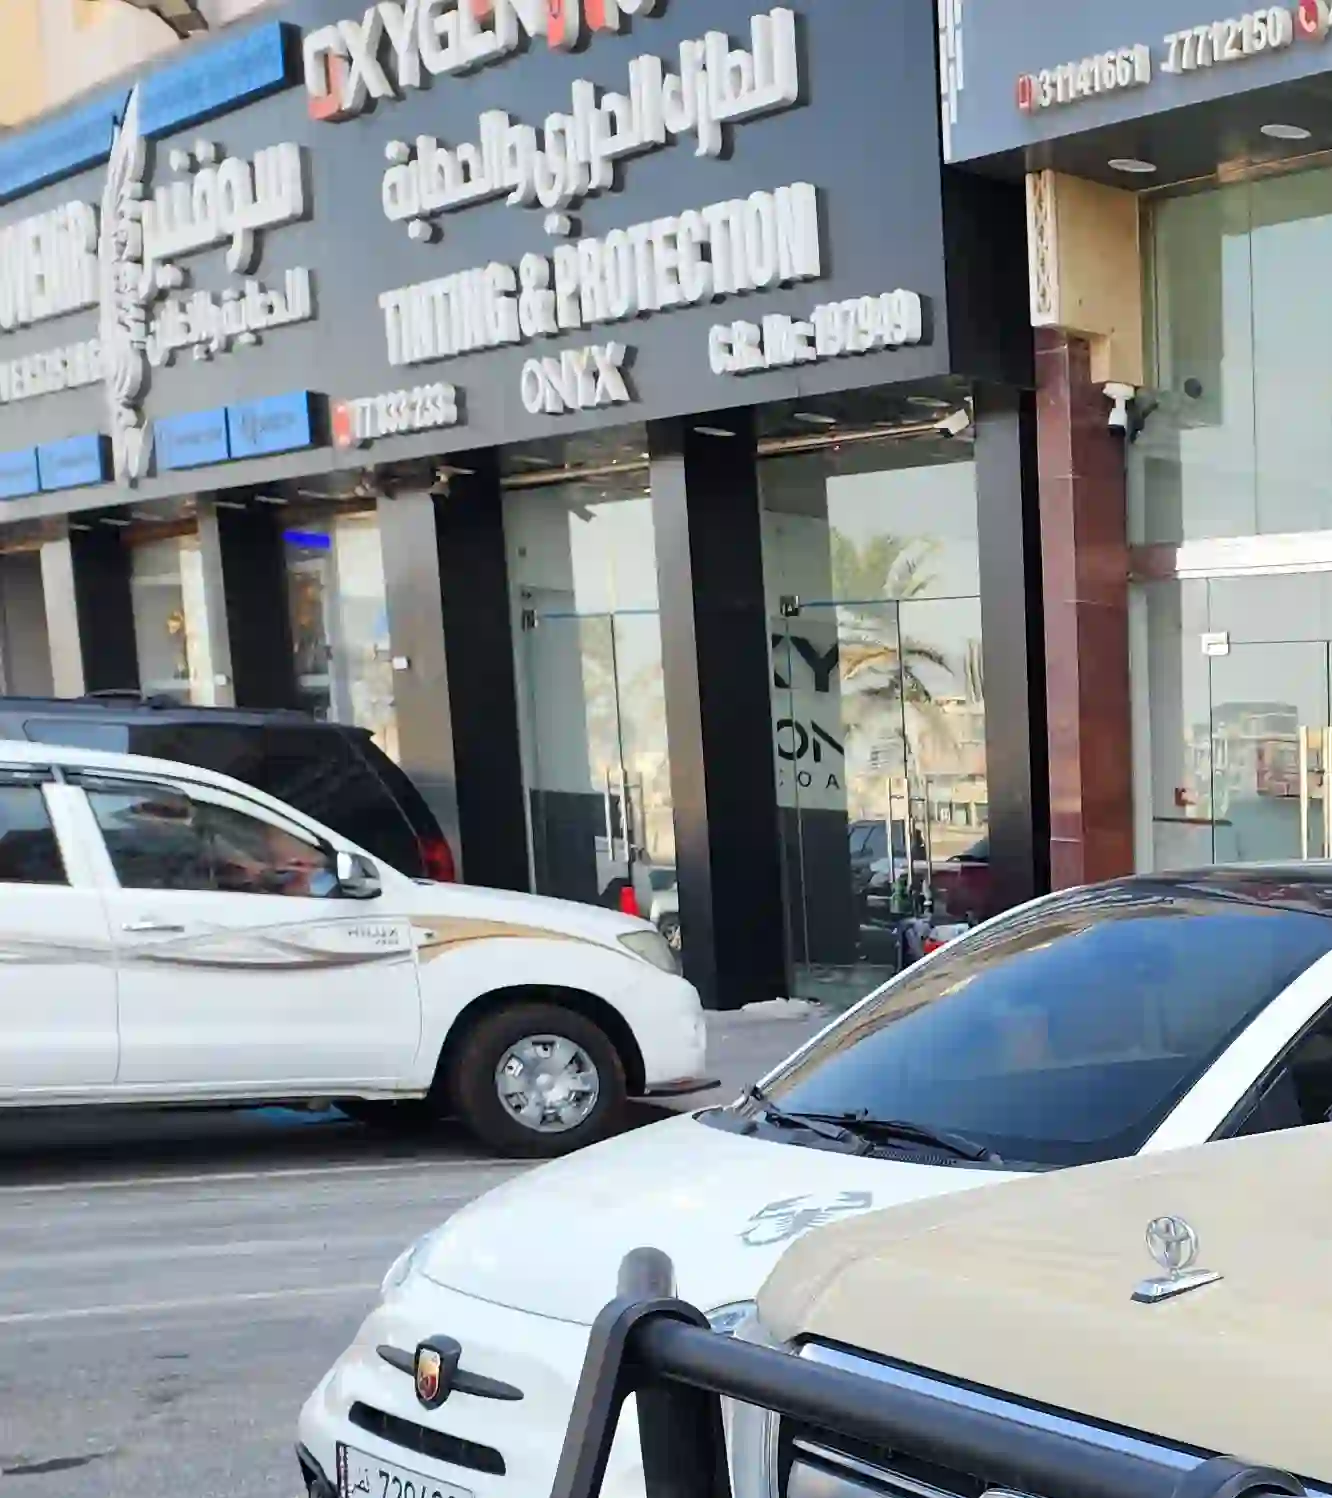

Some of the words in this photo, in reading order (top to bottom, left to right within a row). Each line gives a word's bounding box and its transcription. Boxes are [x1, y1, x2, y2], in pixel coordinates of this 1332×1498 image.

[379, 262, 520, 366] TINTING
[519, 252, 558, 337] &
[553, 181, 820, 328] PROTECTION
[520, 341, 628, 415] ONYX
